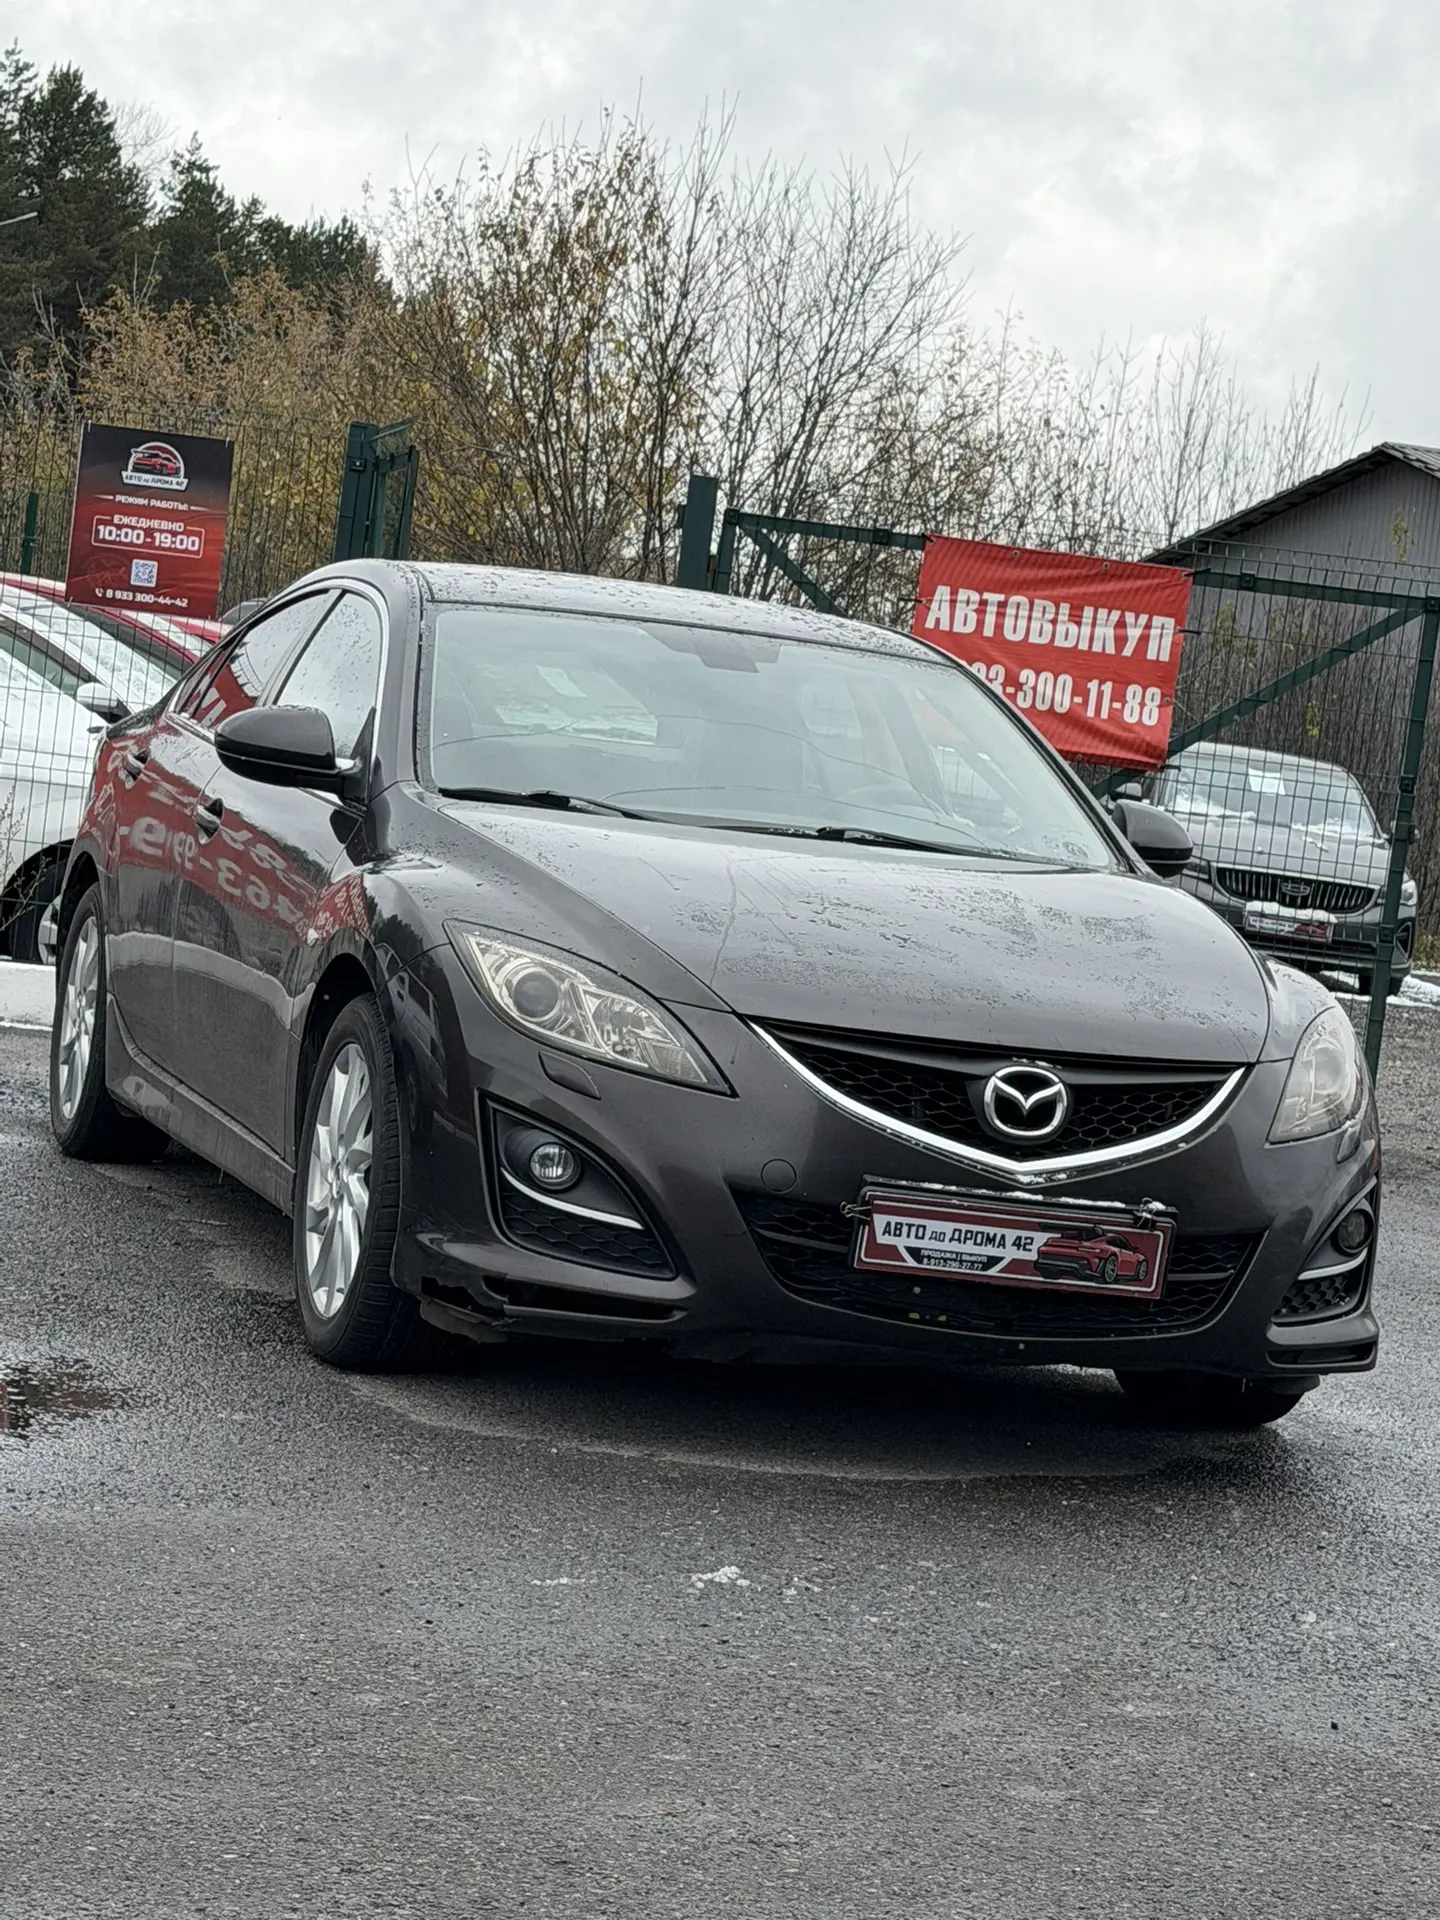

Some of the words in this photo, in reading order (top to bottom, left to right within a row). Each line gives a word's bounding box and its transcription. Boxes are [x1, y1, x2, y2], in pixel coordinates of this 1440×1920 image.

[115, 494, 148, 506] РЕЖИМ
[113, 514, 184, 531] ЕЖЕДНЕВНО
[105, 589, 114, 599] 8
[115, 590, 133, 601] 933
[134, 592, 188, 608] 300-44-42
[924, 584, 1176, 662] АВТОВЫКУП
[881, 1220, 927, 1241] АВТО
[949, 1228, 1007, 1250] ДРОМА
[1011, 1235, 1035, 1252] 42
